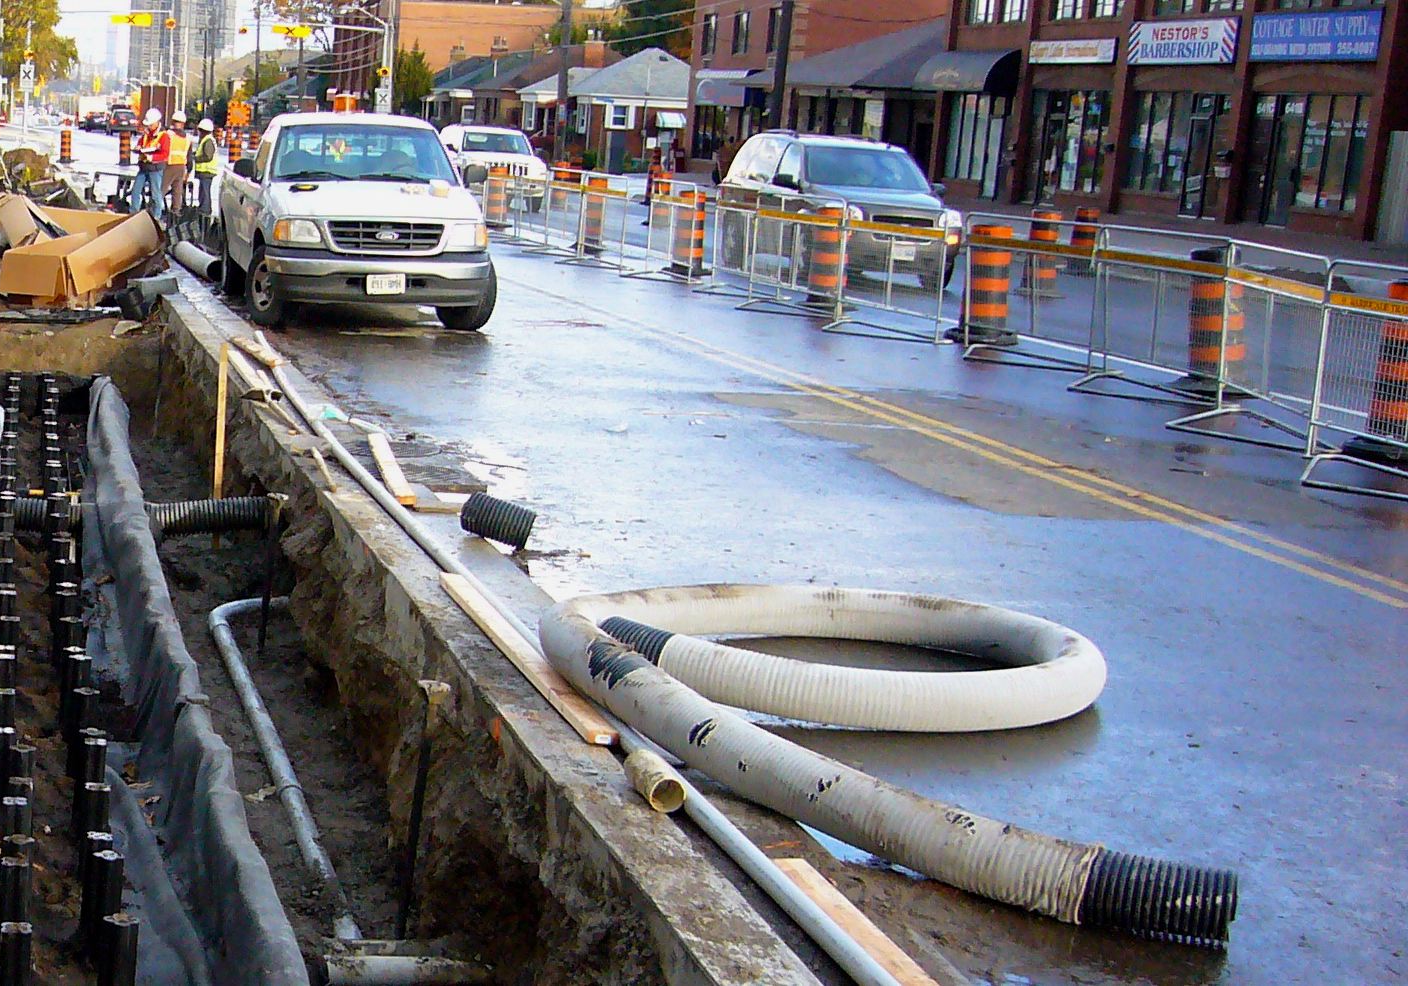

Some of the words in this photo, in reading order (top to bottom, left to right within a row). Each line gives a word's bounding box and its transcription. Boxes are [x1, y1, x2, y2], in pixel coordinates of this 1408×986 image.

[1152, 27, 1209, 41] NESTOR'S
[1253, 18, 1294, 38] COTTAGE
[1299, 17, 1329, 37] WATER
[1335, 15, 1369, 36] SUPPLY
[1140, 41, 1219, 59] BARBERSHOP
